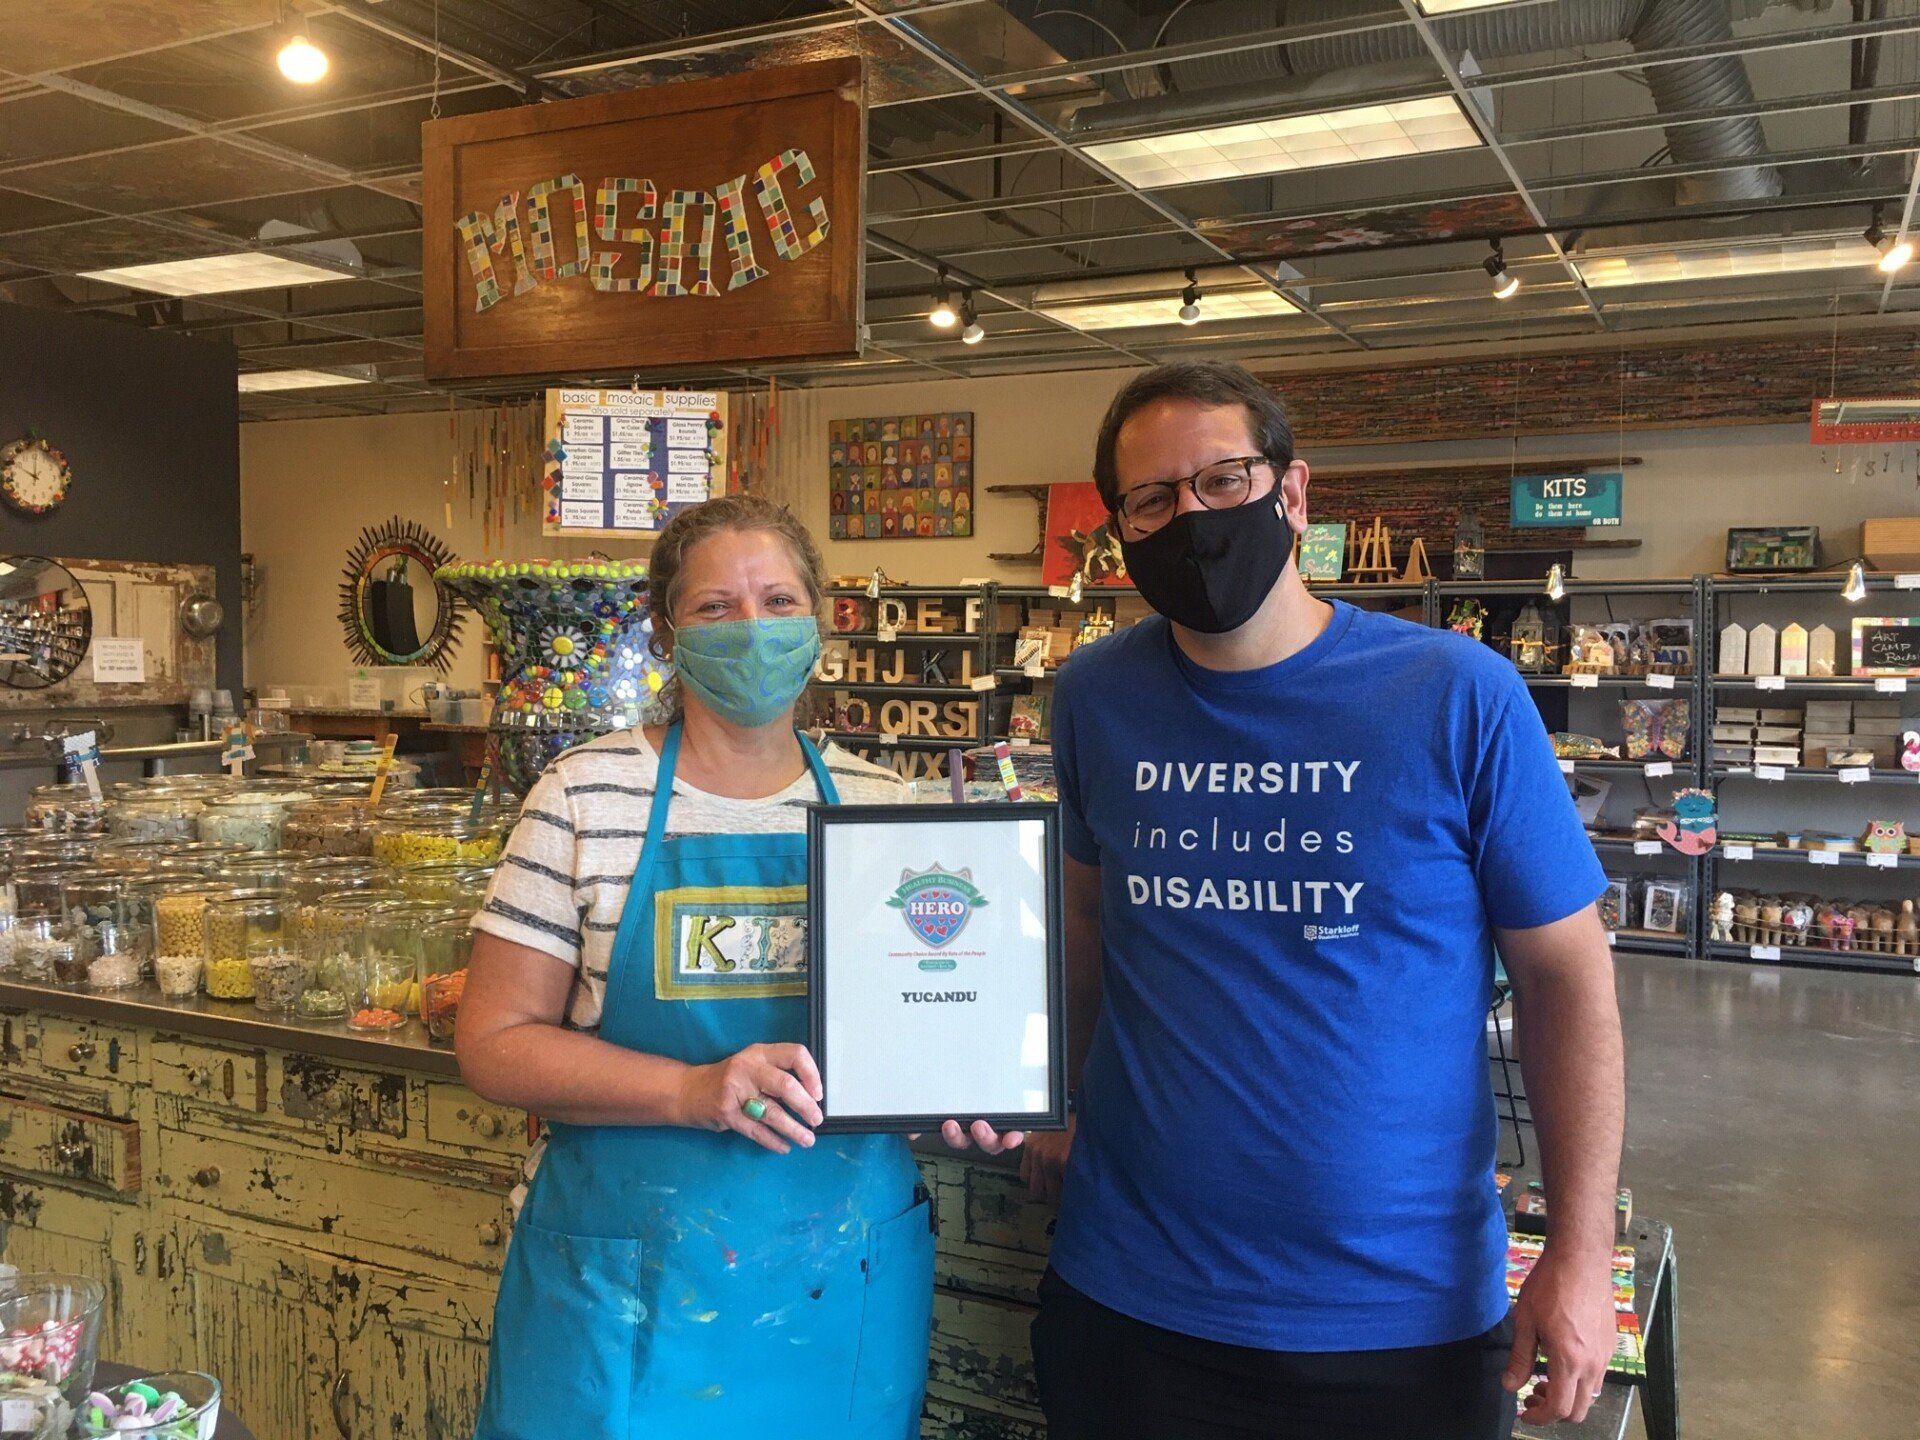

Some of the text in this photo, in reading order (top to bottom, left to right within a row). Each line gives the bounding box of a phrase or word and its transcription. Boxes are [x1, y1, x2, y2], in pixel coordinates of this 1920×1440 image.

[456, 148, 830, 313] MOSAIC
[562, 392, 716, 408] basic mosaic supplies
[591, 406, 675, 418] also sold separately
[1543, 478, 1587, 498] KITS
[1602, 517, 1620, 525] BOTH
[1871, 630, 1900, 642] ART
[1872, 643, 1911, 652] CAMP
[1135, 760, 1361, 794] DIVERSITY
[1133, 816, 1354, 853] includes
[1127, 874, 1365, 914] DISABILITY
[910, 901, 964, 915] HERO
[1318, 924, 1359, 935] Starkloff
[685, 914, 808, 973] KI
[901, 991, 977, 1003] YUCANDU
